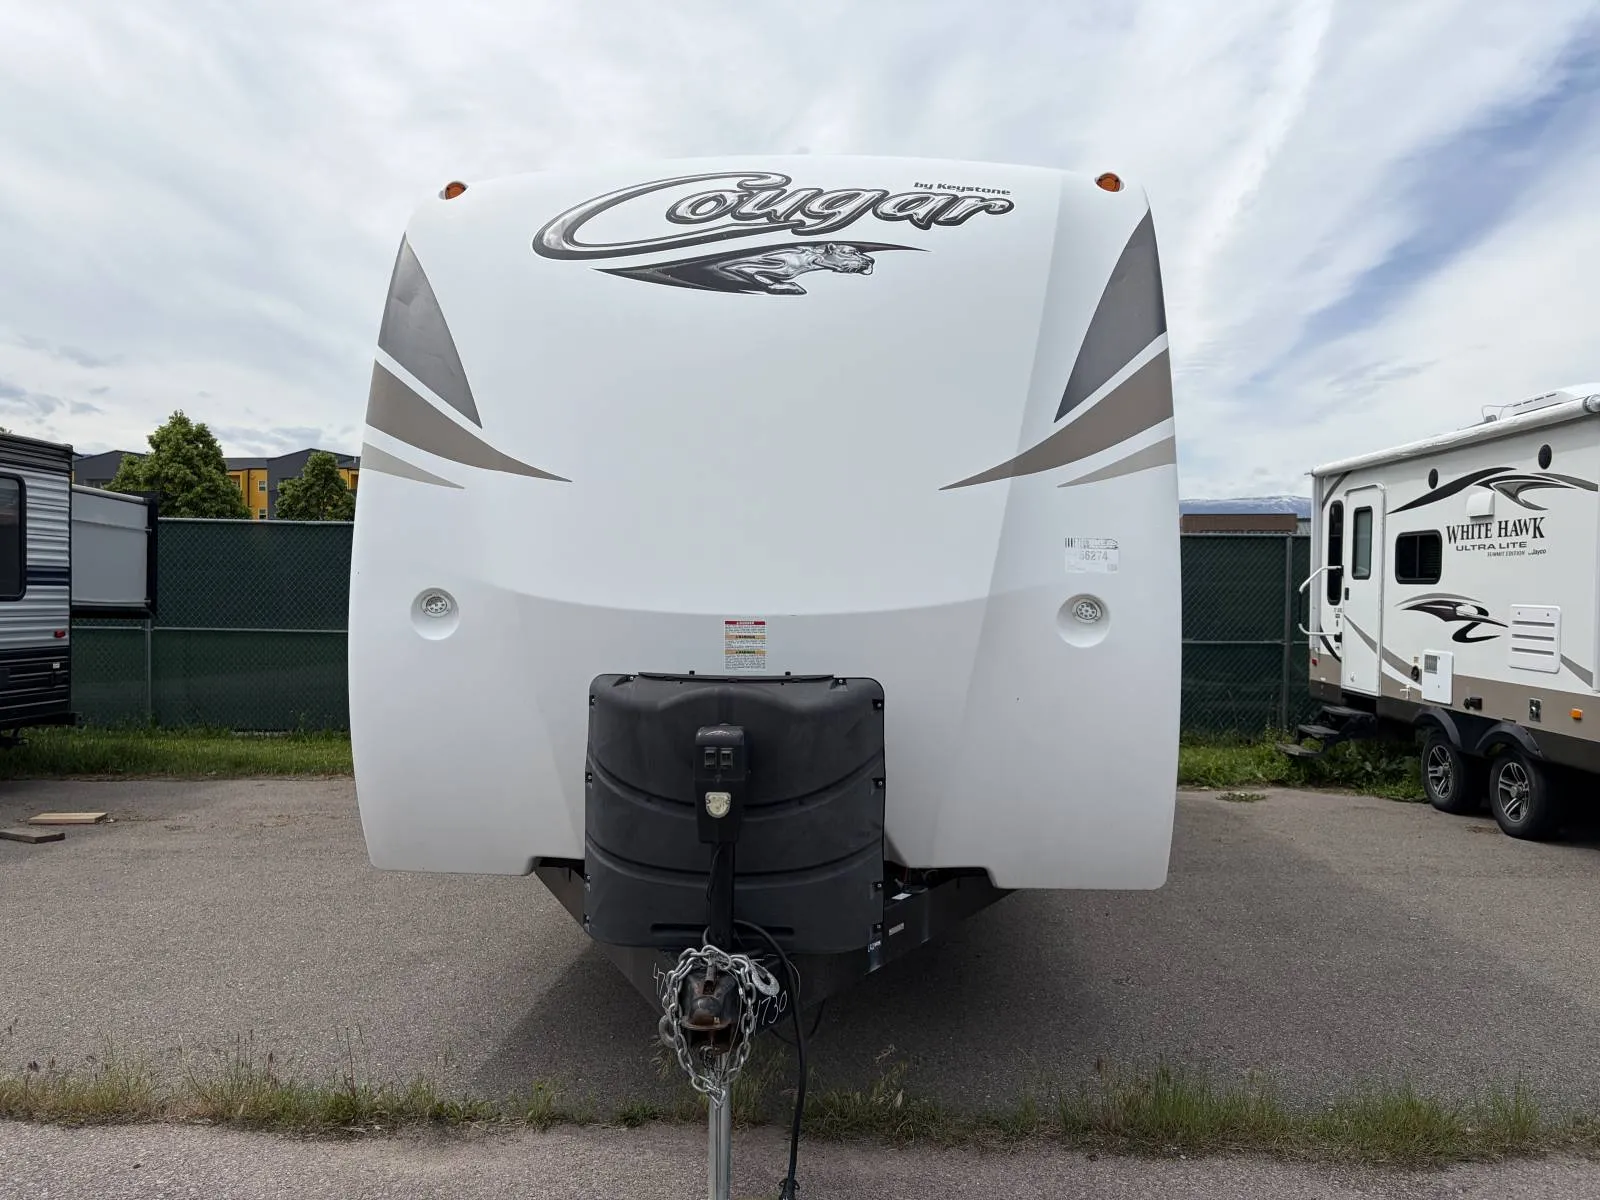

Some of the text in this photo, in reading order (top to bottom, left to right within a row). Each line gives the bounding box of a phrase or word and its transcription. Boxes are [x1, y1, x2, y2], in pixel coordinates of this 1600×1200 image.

[913, 181, 1012, 195] by Keystone
[532, 171, 1015, 260] Cougar
[1446, 517, 1545, 544] WHITE HAWK
[1456, 541, 1527, 551] ULTRA LITE
